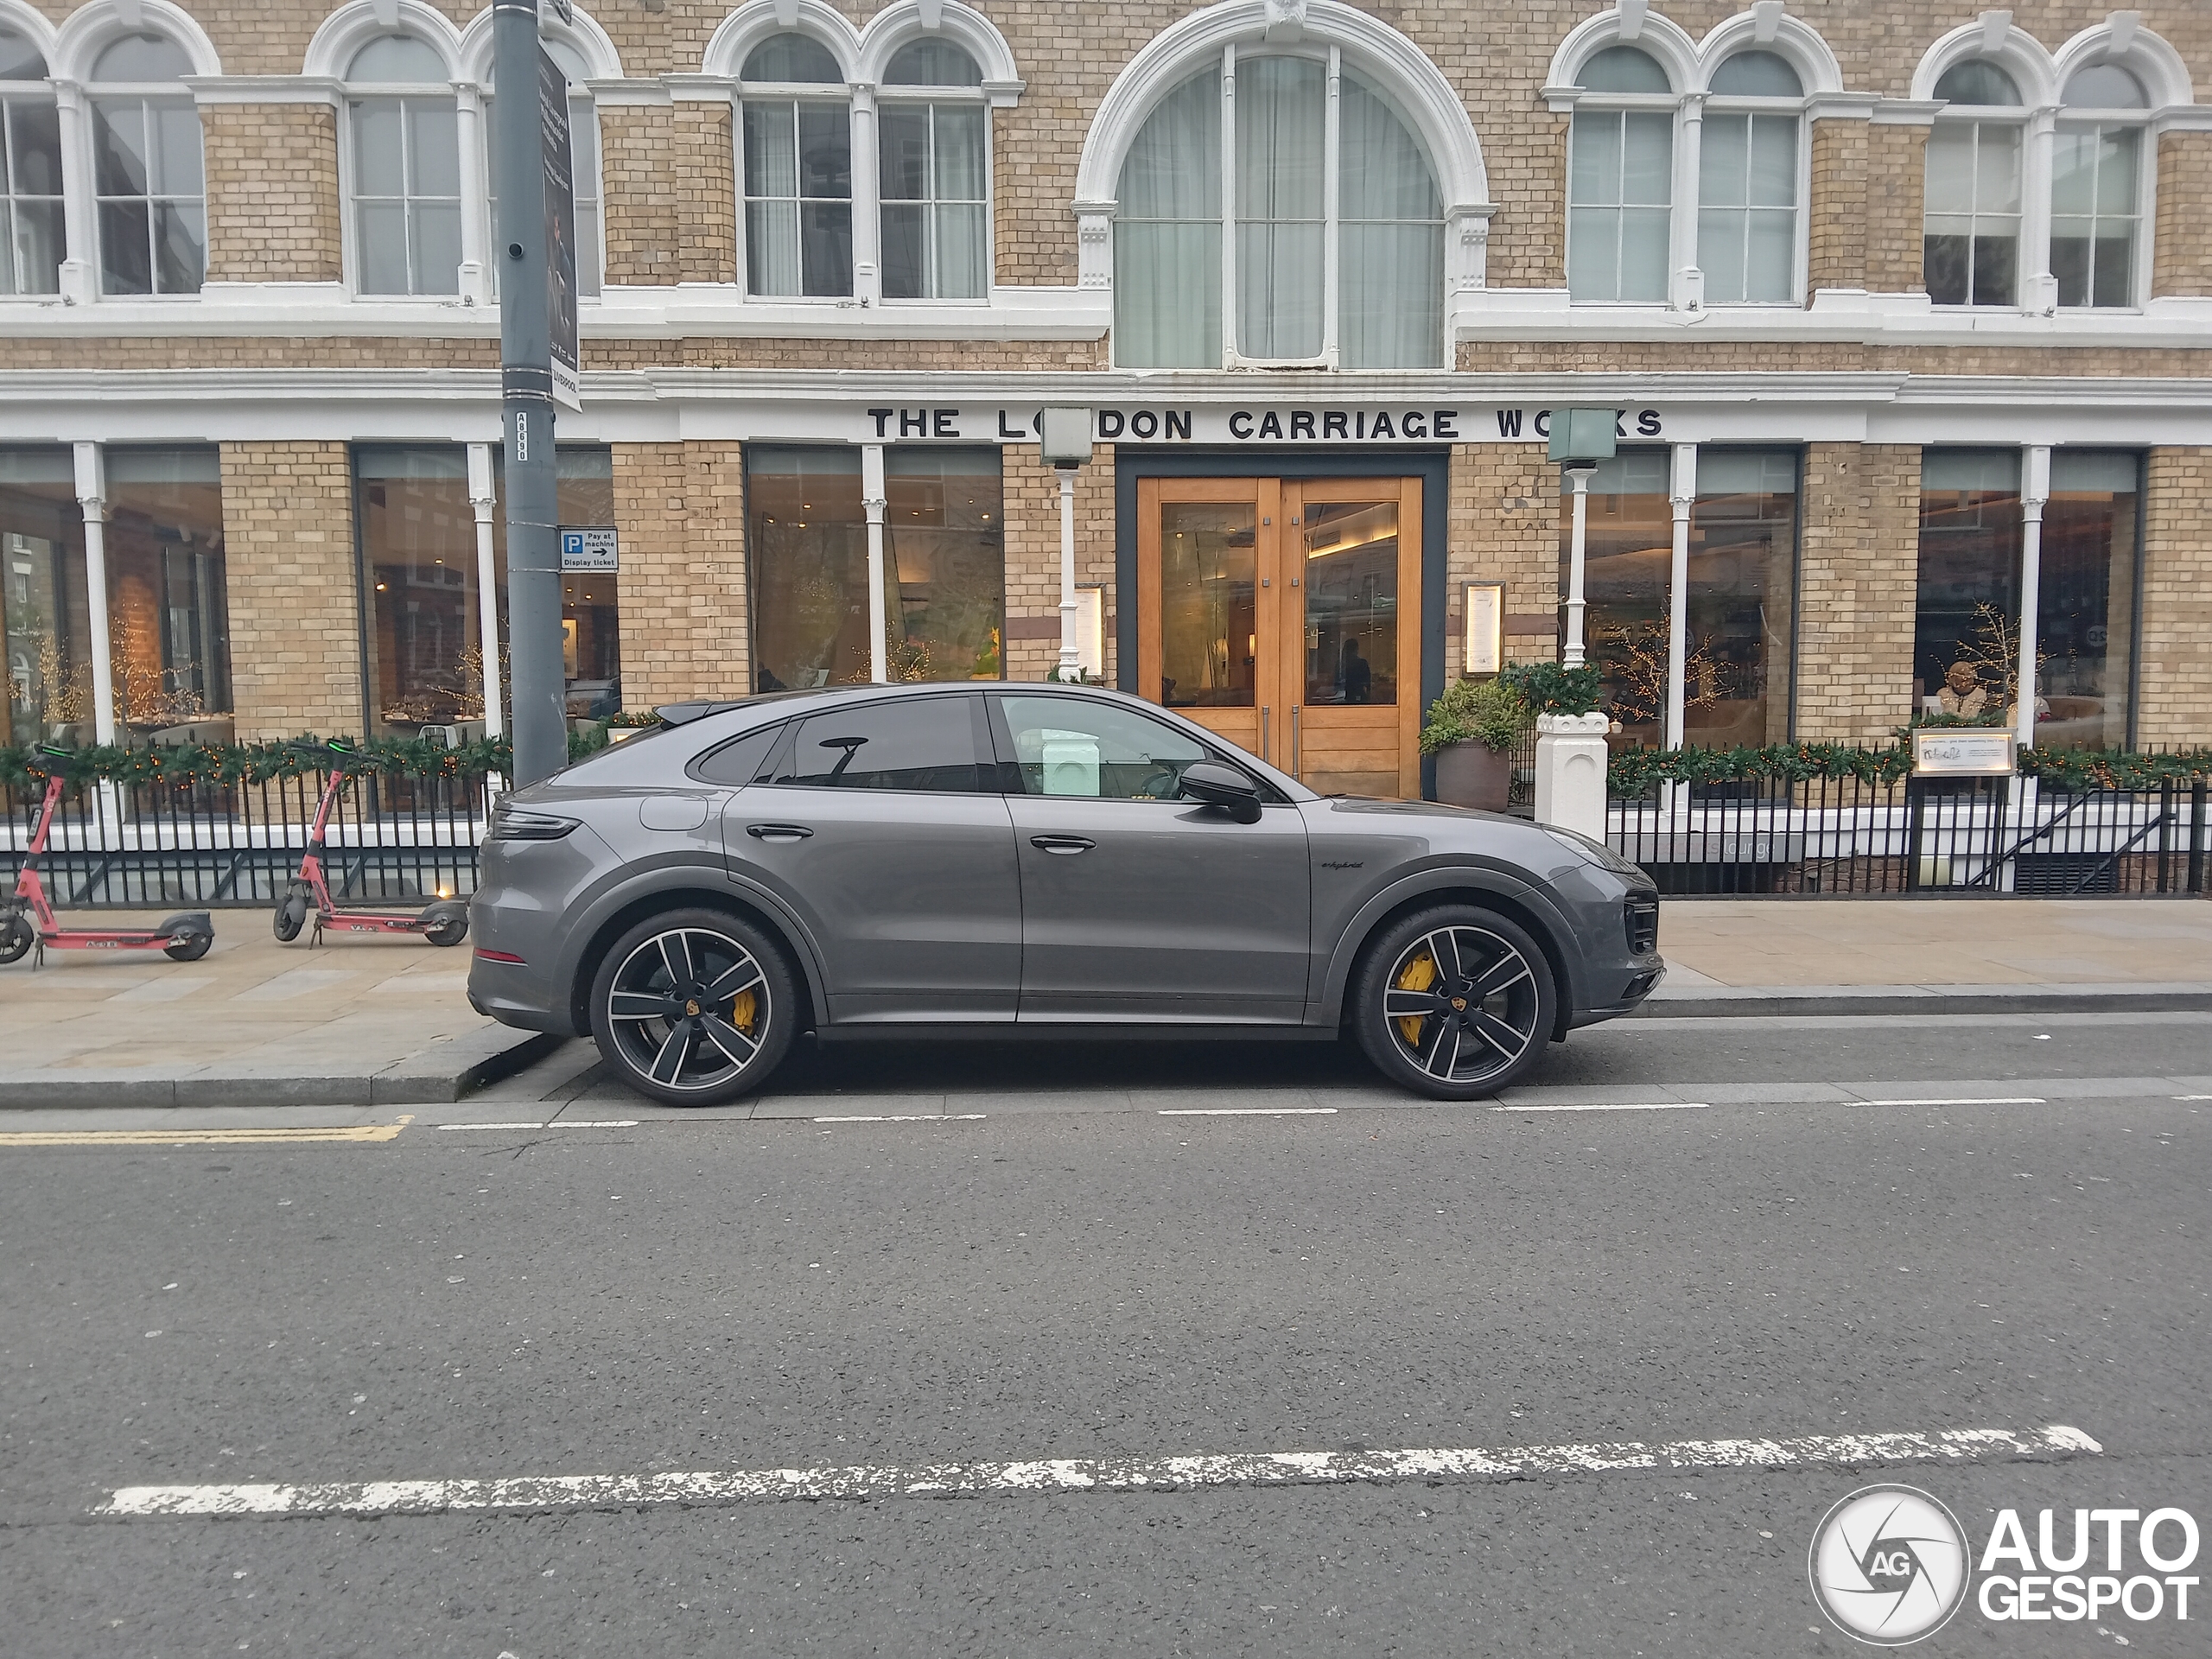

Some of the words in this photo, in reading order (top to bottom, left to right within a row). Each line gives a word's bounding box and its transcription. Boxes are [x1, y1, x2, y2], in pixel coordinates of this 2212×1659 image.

[868, 409, 960, 437] THE
[998, 410, 1192, 440] LDON
[1229, 410, 1459, 440] CARRIAGE
[568, 537, 580, 552] P
[1723, 839, 1775, 859] lounge
